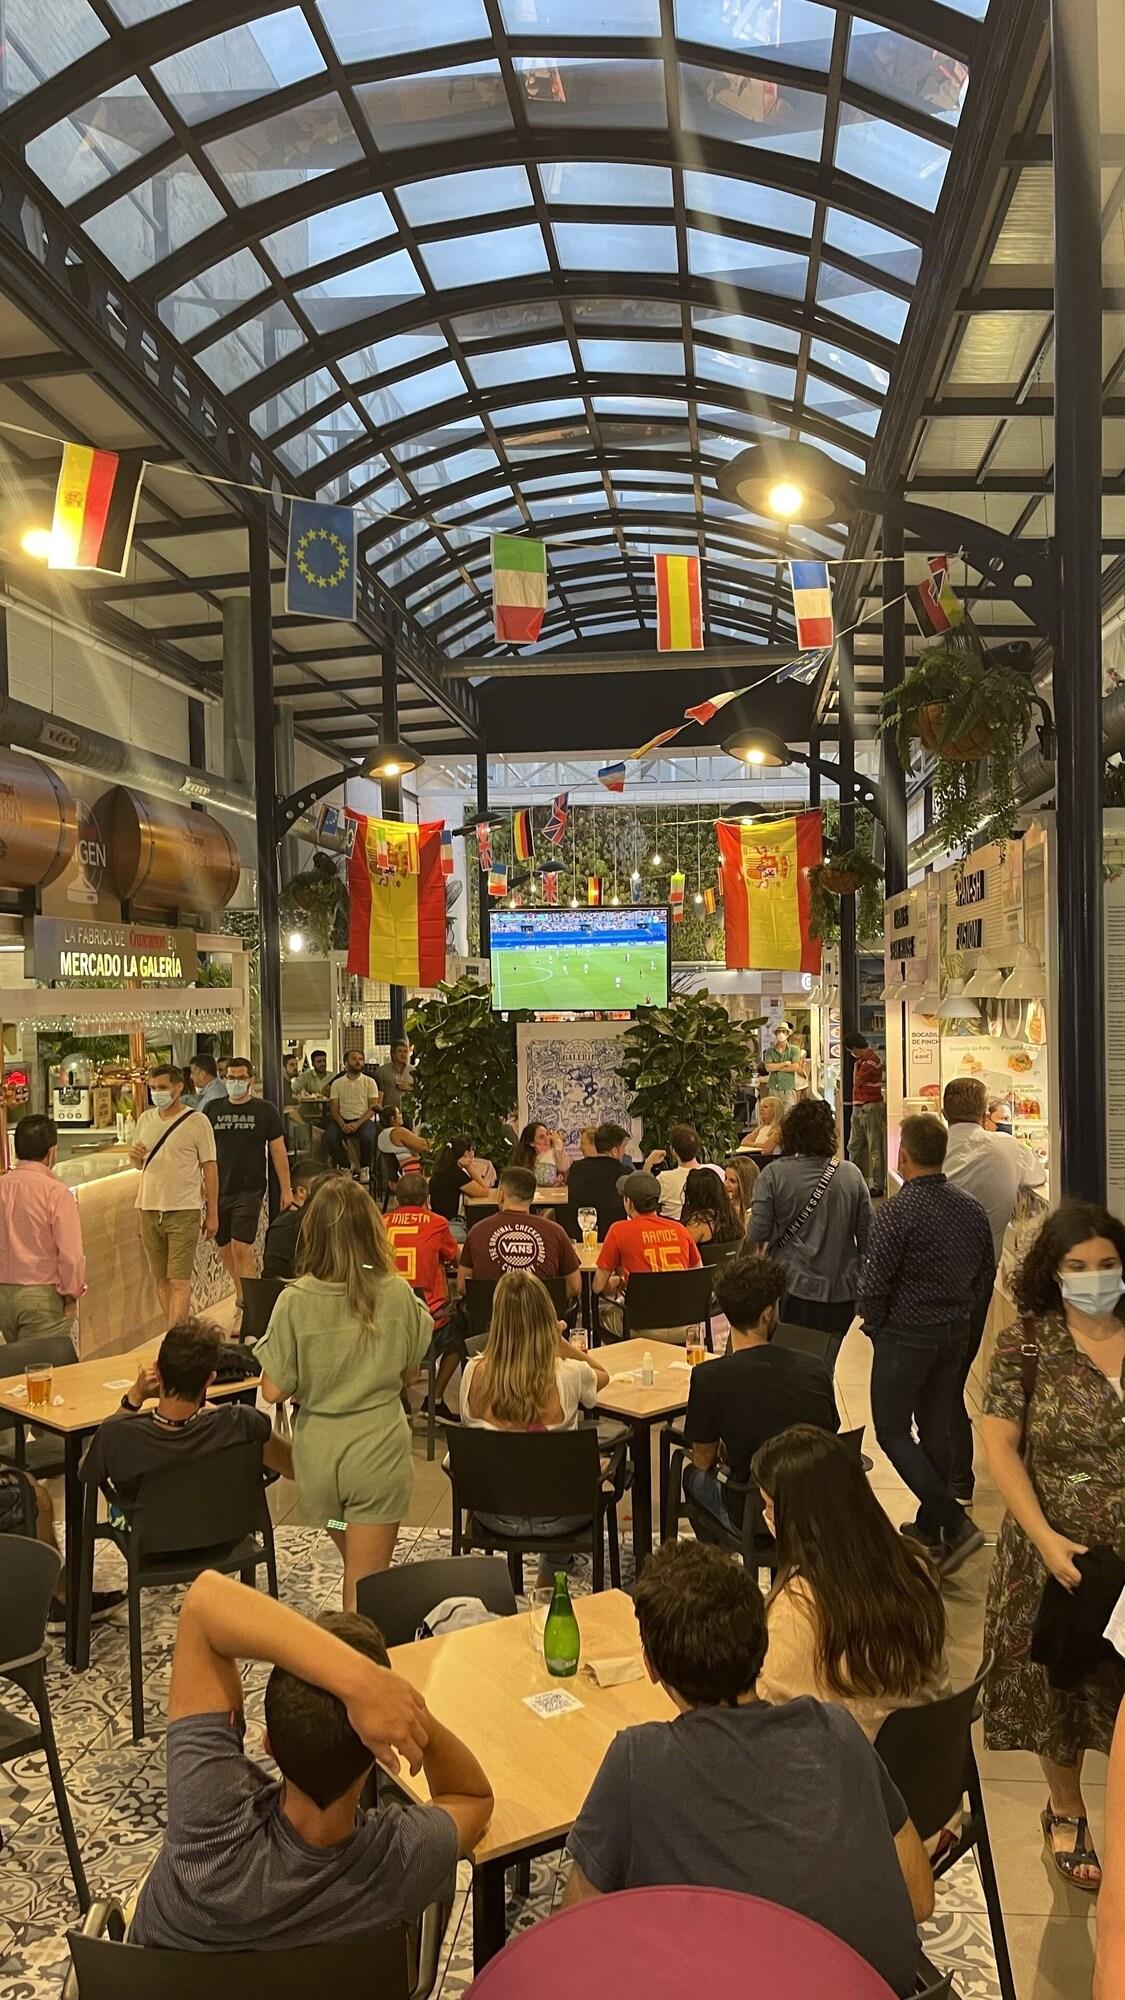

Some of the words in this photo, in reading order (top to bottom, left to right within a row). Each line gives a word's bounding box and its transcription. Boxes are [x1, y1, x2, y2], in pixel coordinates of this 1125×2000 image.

[64, 928, 75, 943] LA
[78, 928, 112, 946] FABRICA
[115, 930, 125, 947] DE
[60, 952, 120, 977] MERCADO
[123, 955, 138, 977] LA
[140, 951, 182, 978] GALERÍA
[217, 1115, 255, 1123] URBAN
[488, 1224, 514, 1247] ORIGINAL
[642, 1229, 679, 1244] RAMOS
[488, 1247, 499, 1261] THE
[501, 1241, 534, 1255] VANS
[644, 1246, 685, 1272] 15
